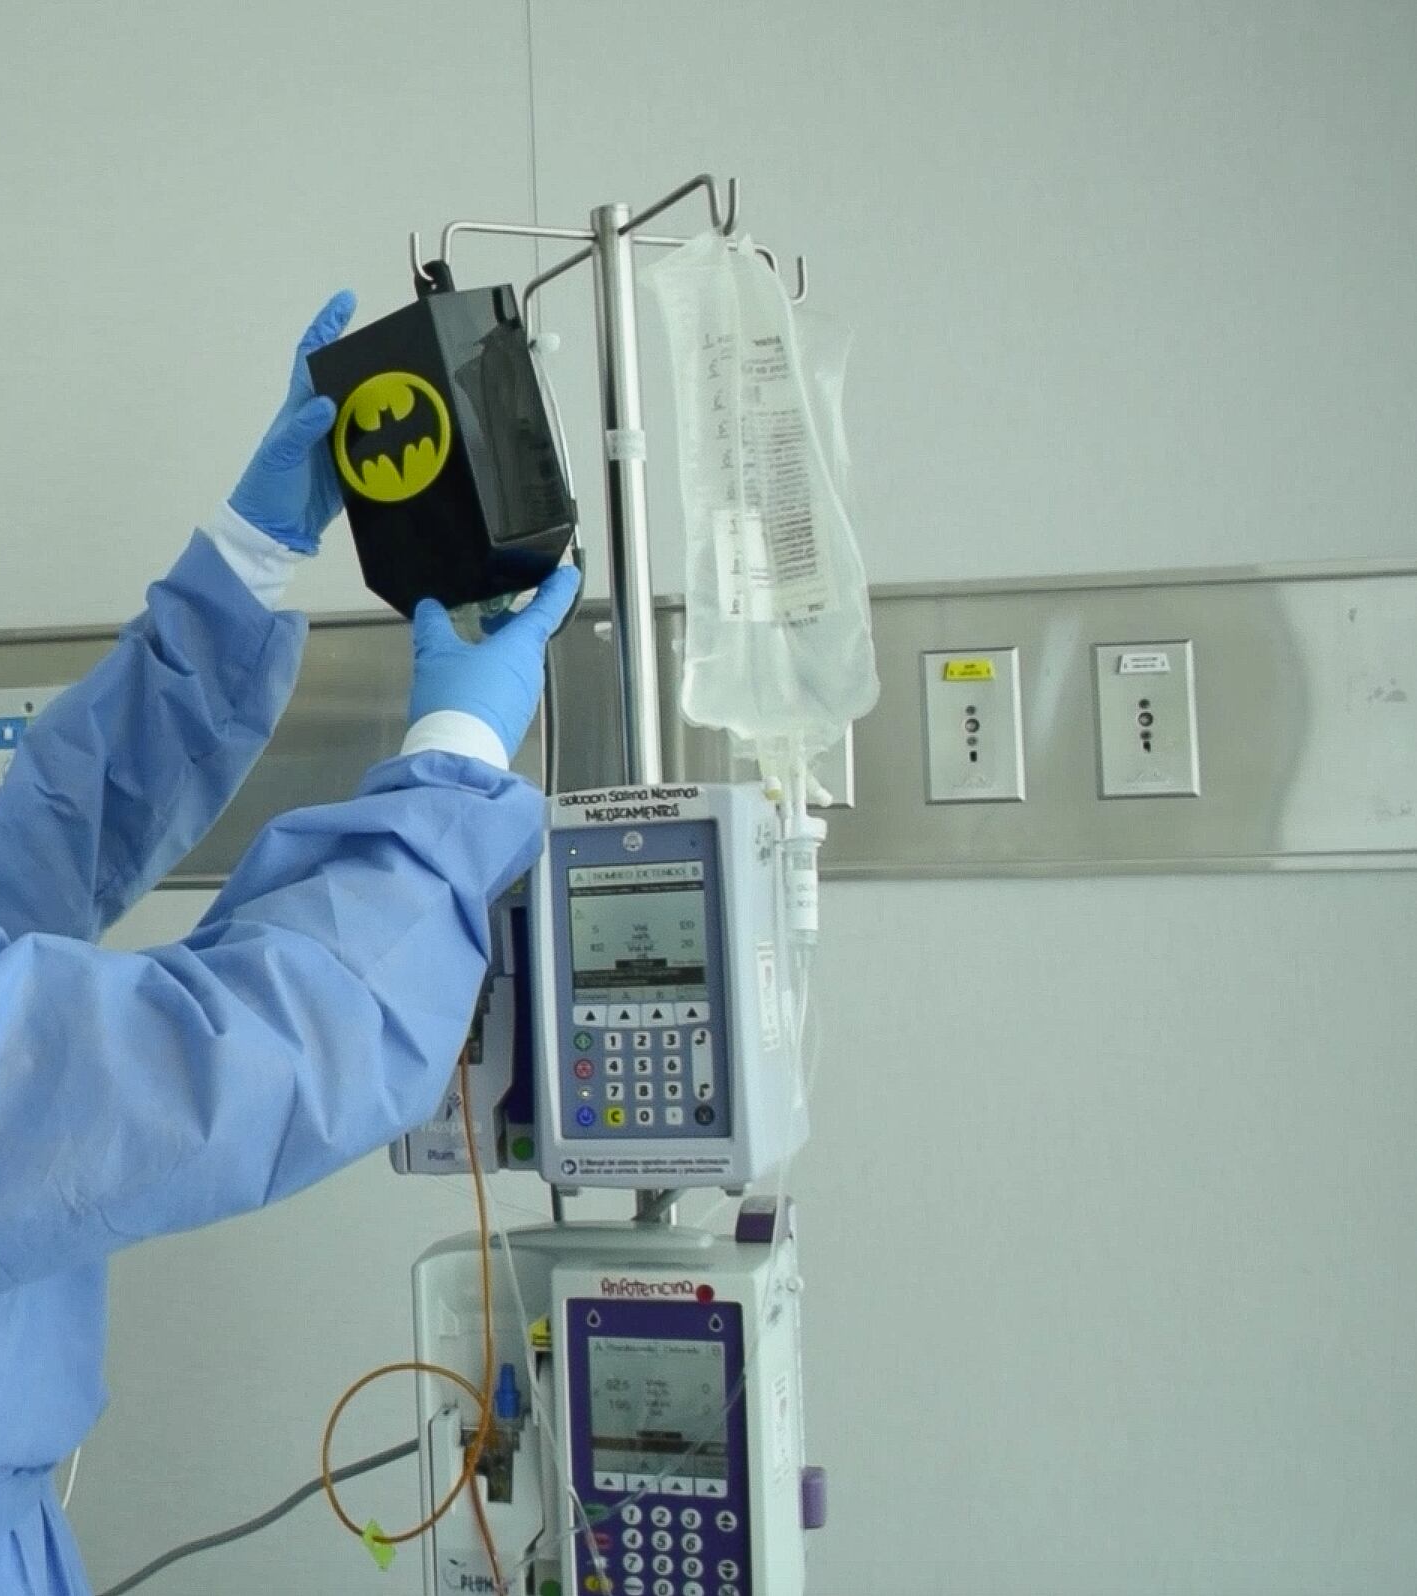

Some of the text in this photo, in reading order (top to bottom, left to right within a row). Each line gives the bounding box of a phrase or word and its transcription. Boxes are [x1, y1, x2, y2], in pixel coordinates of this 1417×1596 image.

[651, 786, 698, 799] Normal
[585, 803, 680, 822] MEDICAMENTOS
[610, 1034, 676, 1047] 1 2 3
[609, 1060, 676, 1072] 4 5 6
[610, 1085, 678, 1097] 7 8 9
[610, 1110, 650, 1123] C 0
[628, 1510, 695, 1525] 1 2 3
[627, 1533, 696, 1549] 4 5 6
[628, 1557, 697, 1574] 7 8 9
[658, 1583, 668, 1595] 0
